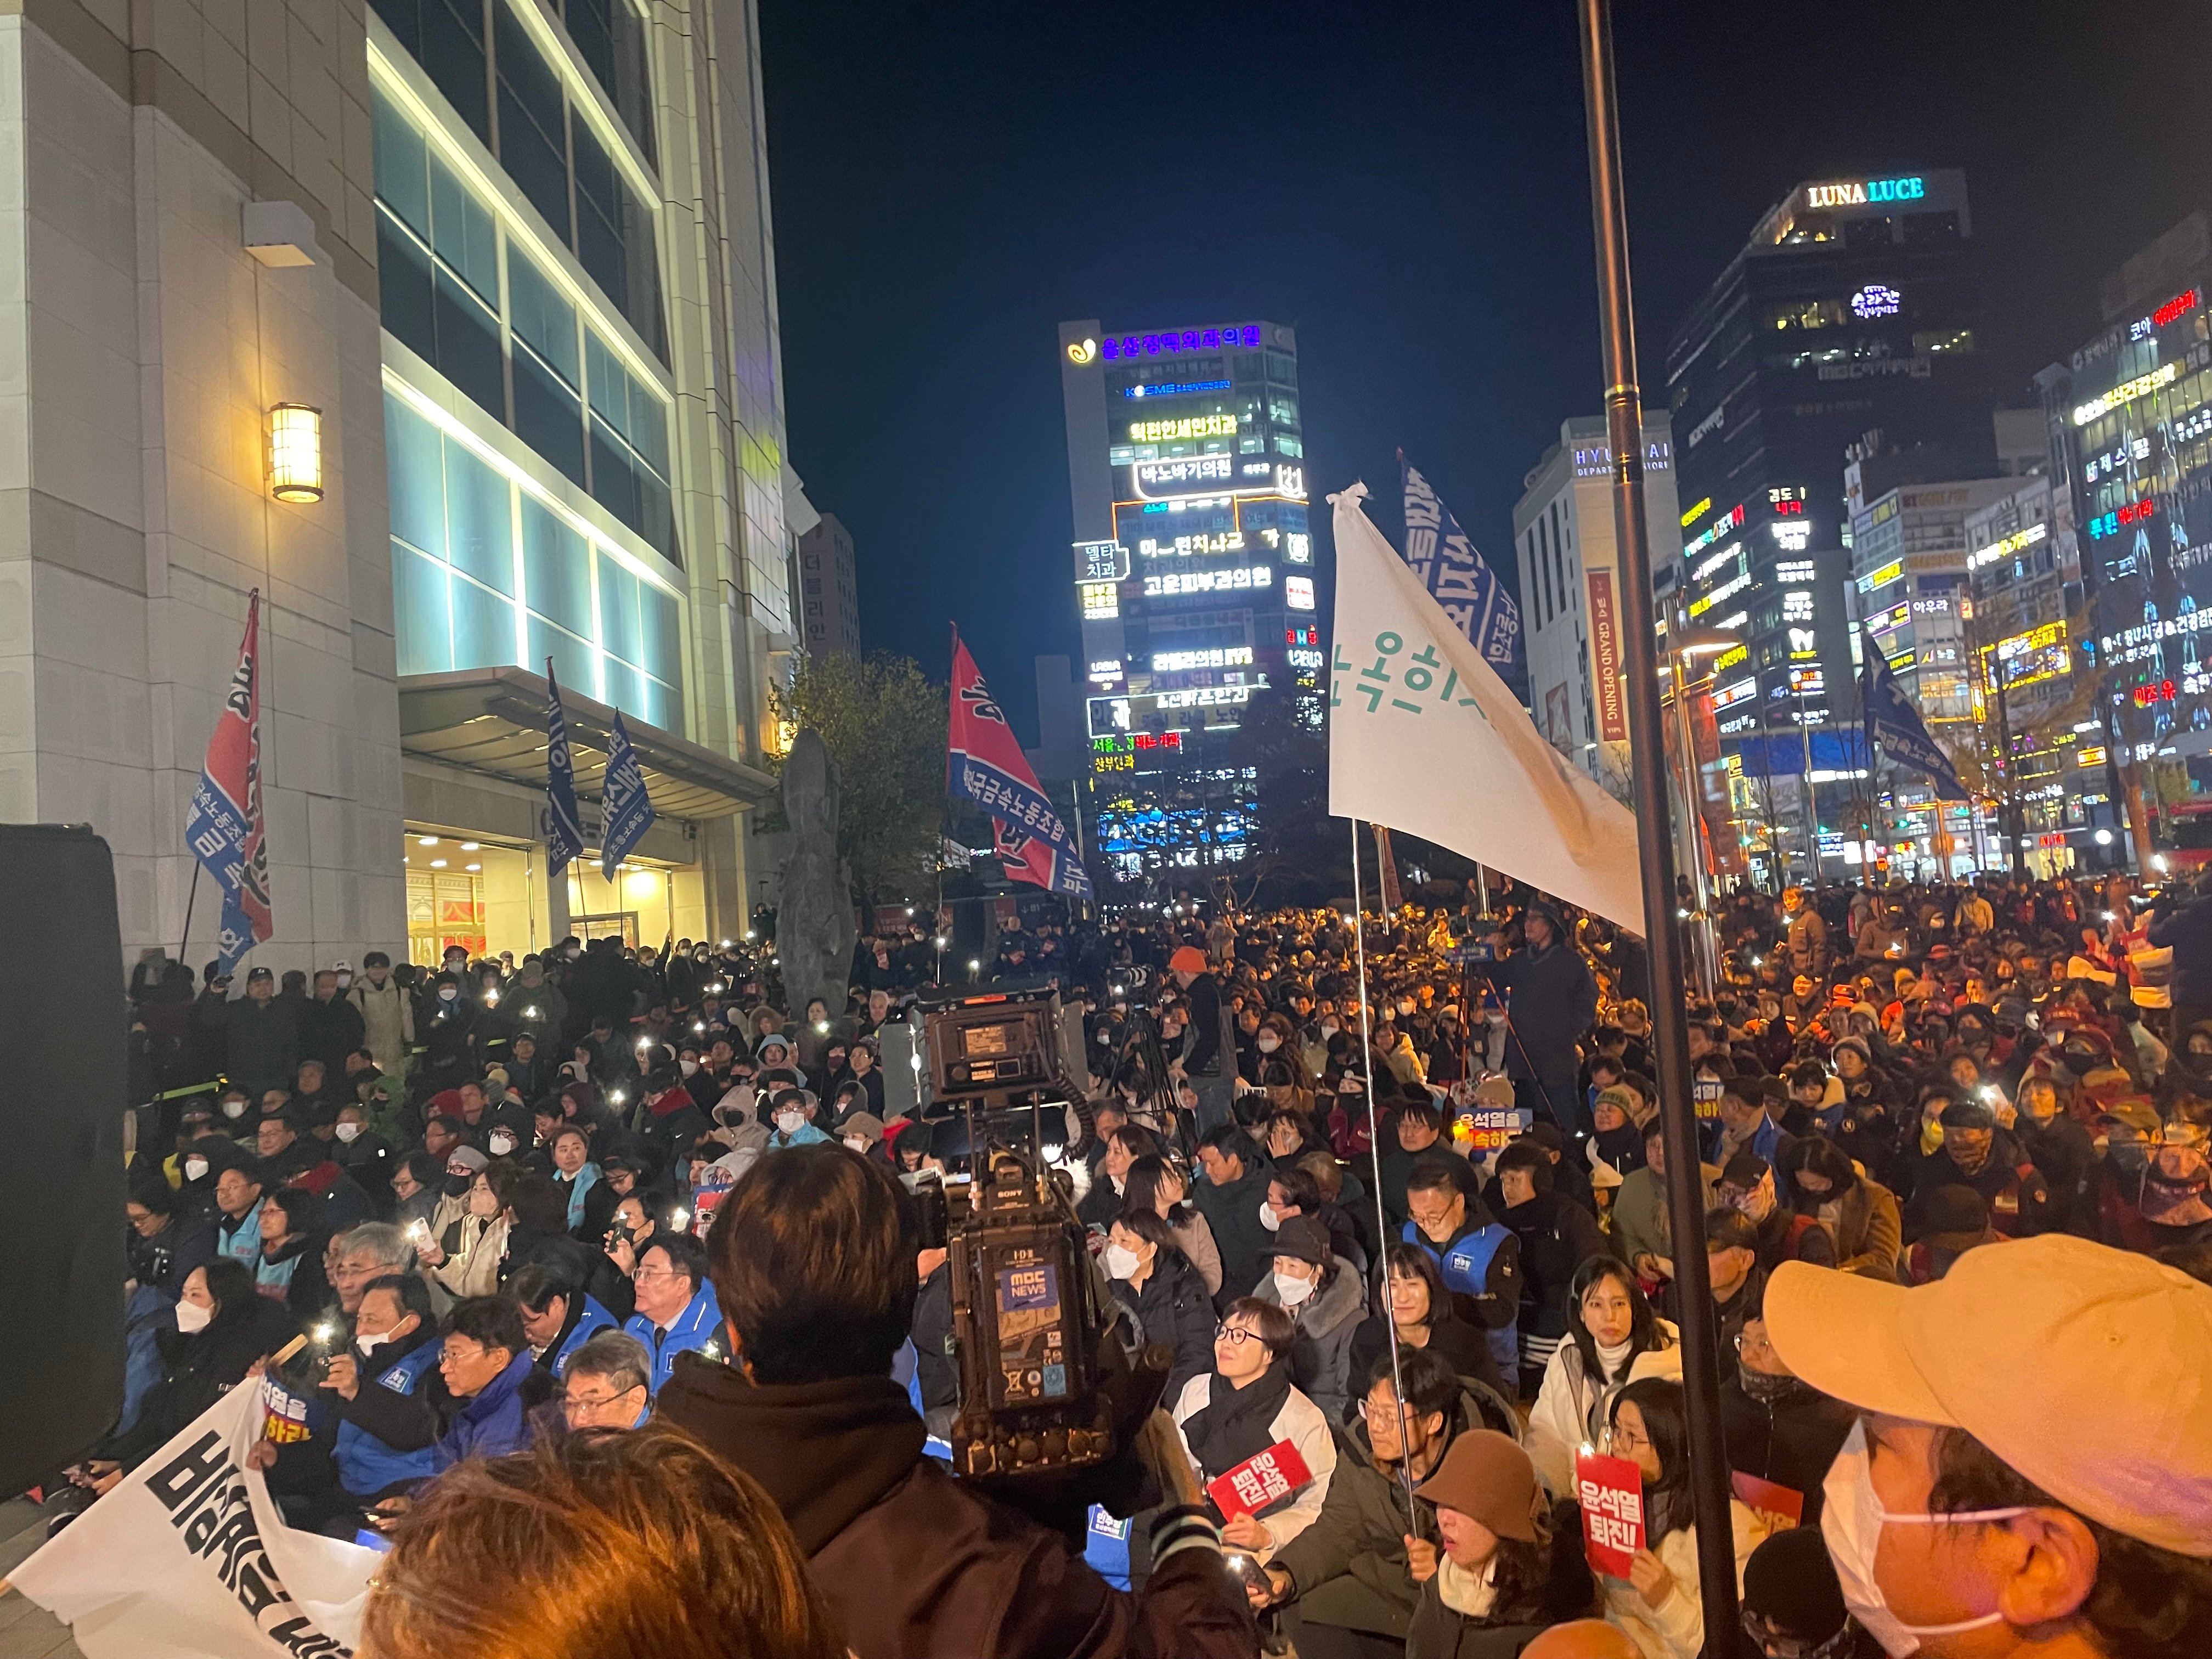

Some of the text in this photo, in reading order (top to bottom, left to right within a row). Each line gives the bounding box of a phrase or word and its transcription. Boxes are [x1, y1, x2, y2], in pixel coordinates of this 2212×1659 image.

[1808, 177, 1924, 207] LUNA LUCE
[1102, 325, 1260, 359] 울산청맥외과의원
[1576, 443, 1669, 465] HYUAI
[1141, 459, 1232, 483] 바노바기의원
[1085, 544, 1115, 561] 델타
[1087, 562, 1117, 579] 치과
[1144, 567, 1272, 596] 고운피부과의원
[1912, 599, 1949, 614] 아우라
[1598, 620, 1619, 721] GRAND OPENING
[997, 1189, 1023, 1198] SONY
[1011, 1271, 1045, 1286] MBC
[1011, 1283, 1046, 1299] NEWS
[1250, 1451, 1291, 1500] 윤석열
[1581, 1480, 1641, 1524] 윤석열
[1589, 1513, 1637, 1554] 퇴진!
